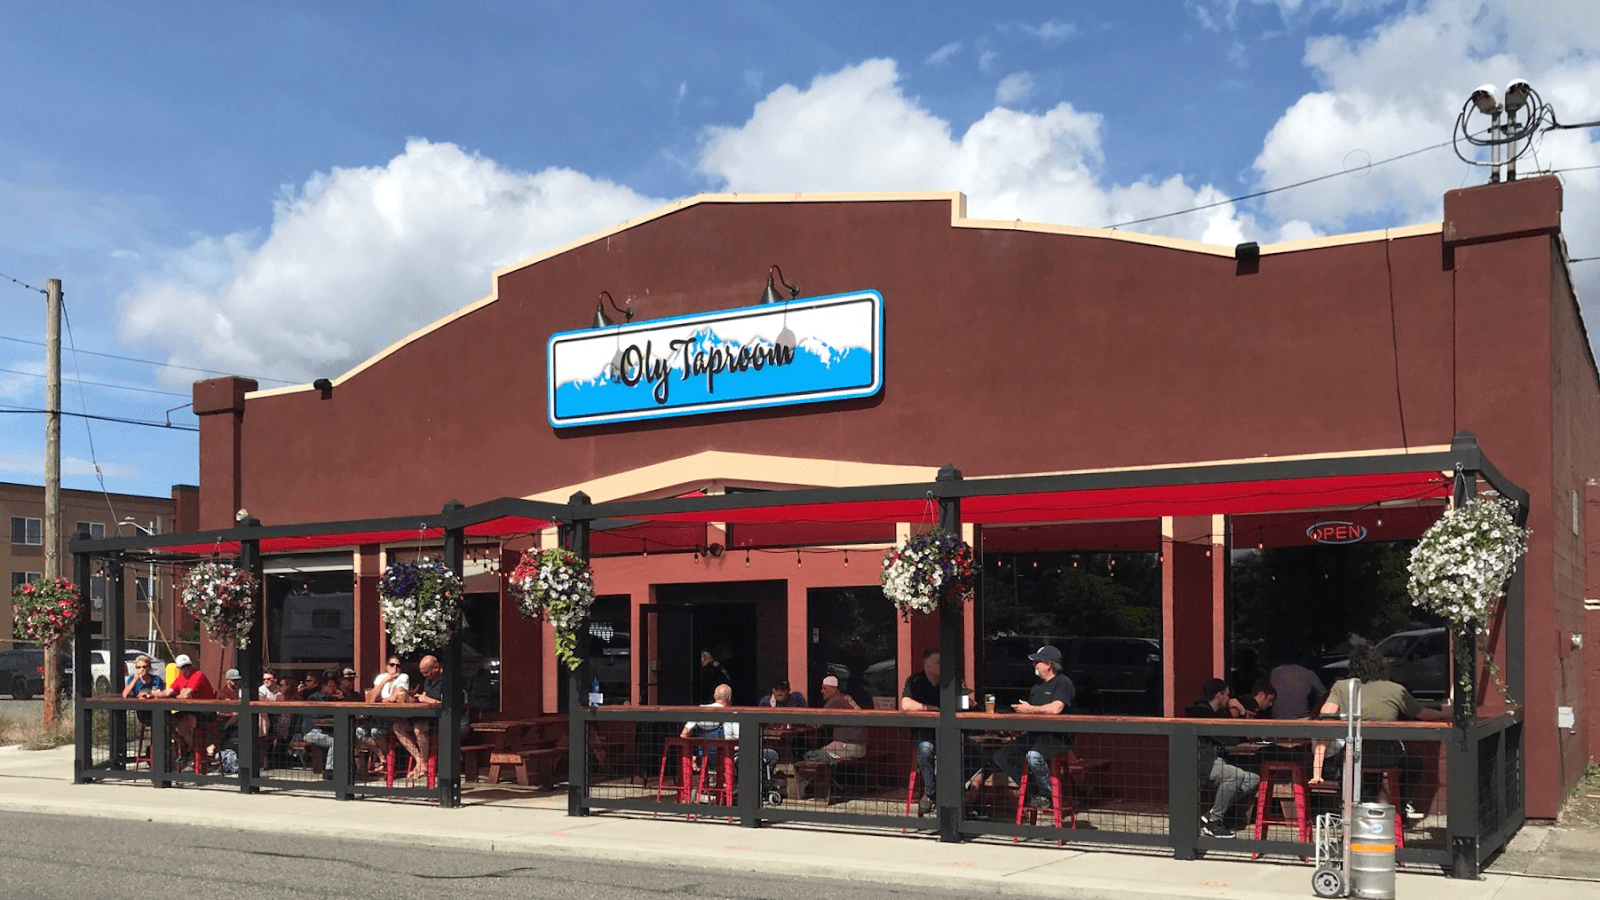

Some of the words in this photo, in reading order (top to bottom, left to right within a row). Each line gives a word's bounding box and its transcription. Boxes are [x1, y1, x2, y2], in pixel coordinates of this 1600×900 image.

[620, 340, 670, 404] Oly
[670, 337, 795, 393] Taproom
[1310, 525, 1360, 540] OPEN
